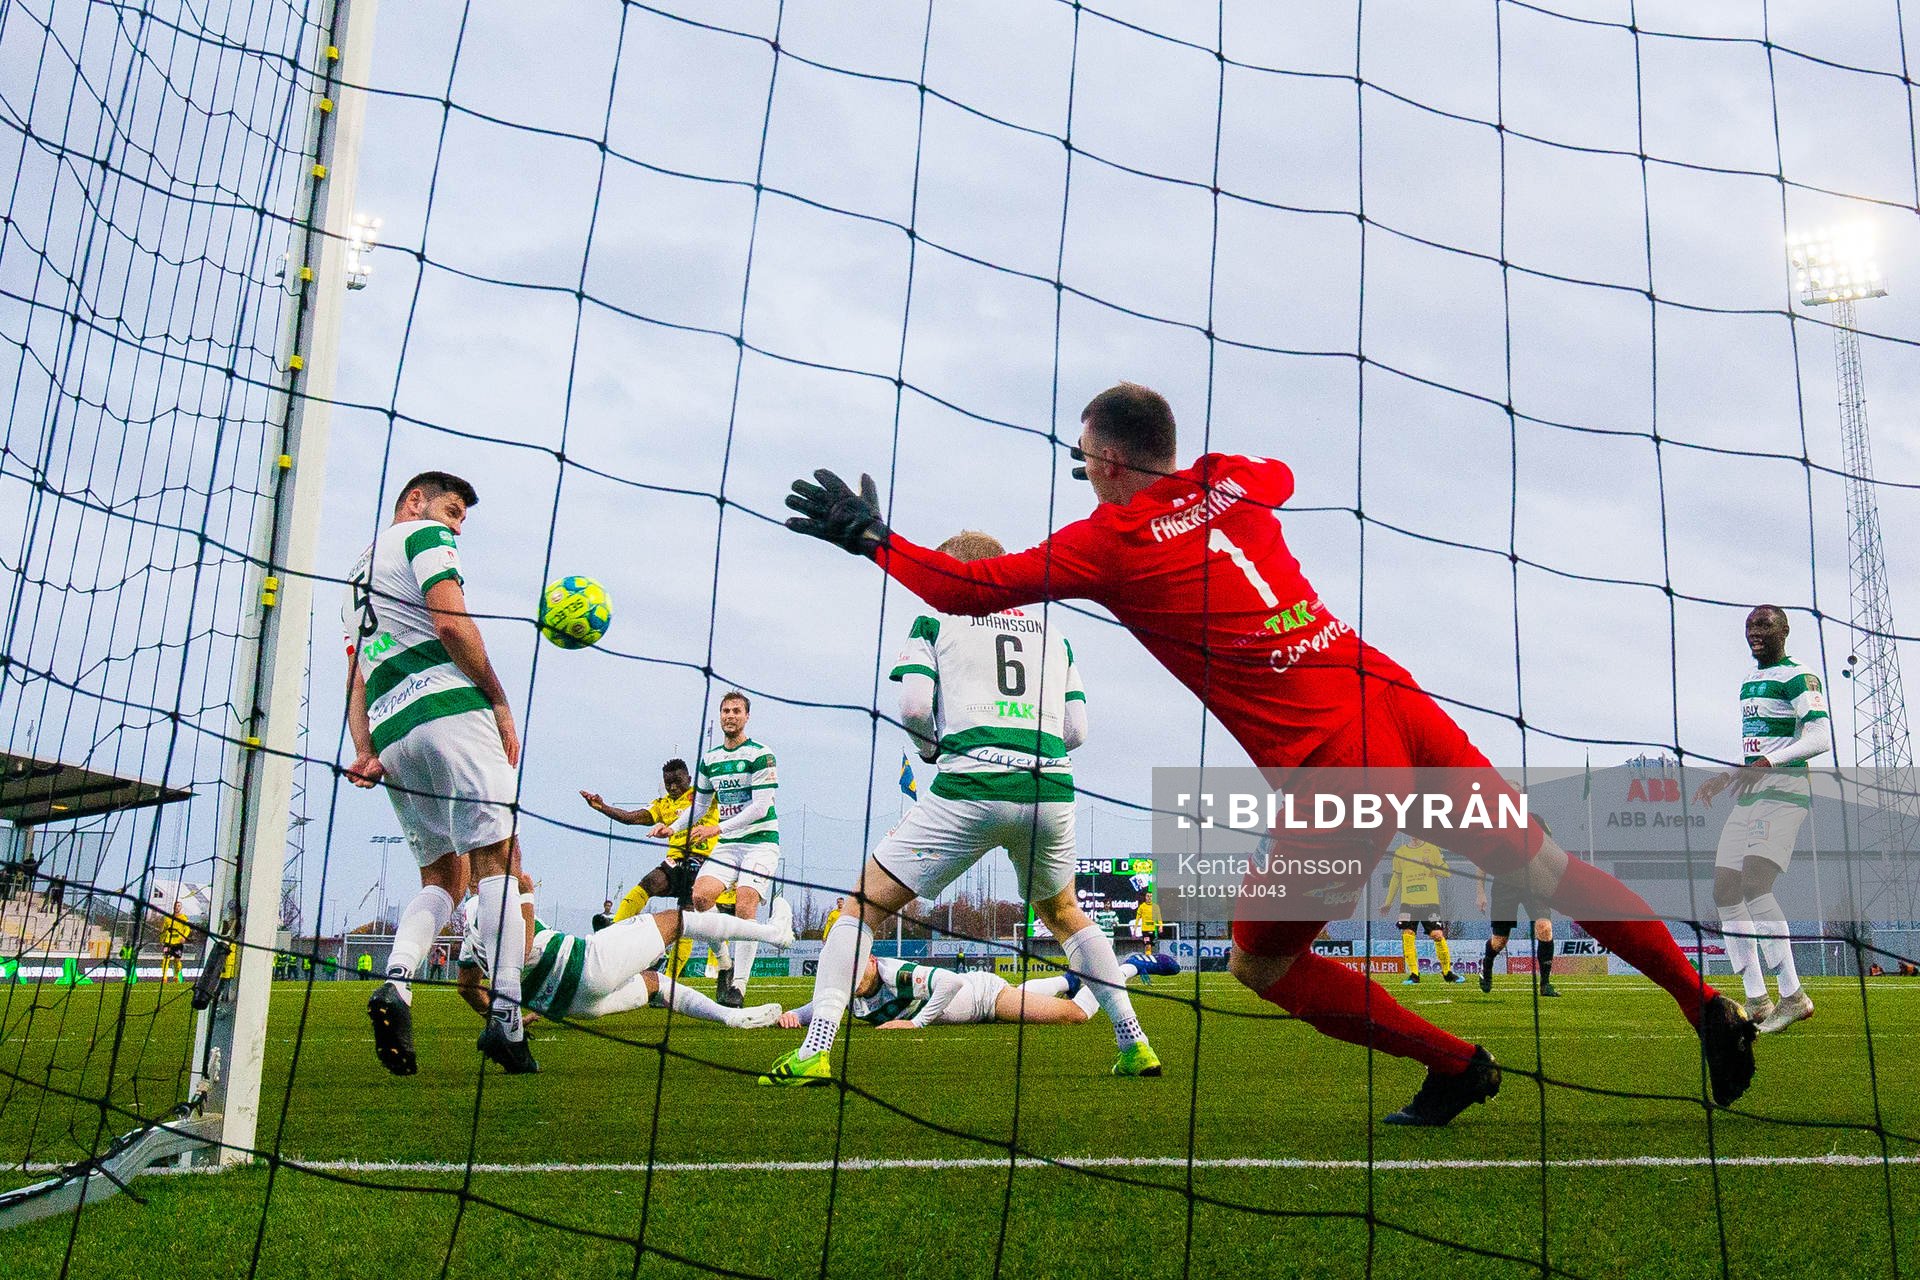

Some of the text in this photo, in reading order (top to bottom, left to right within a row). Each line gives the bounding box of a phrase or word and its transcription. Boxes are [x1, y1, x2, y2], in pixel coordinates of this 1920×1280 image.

[1208, 528, 1280, 610] 1
[352, 570, 379, 638] 5
[1263, 599, 1317, 635] TAK
[970, 614, 1043, 634] JOHANSSON
[362, 631, 398, 663] TAK
[995, 634, 1027, 697] 6
[994, 700, 1036, 720] TAK
[719, 779, 741, 789] ABAX
[1626, 778, 1681, 803] ABB
[1606, 811, 1706, 827] ABB Arena
